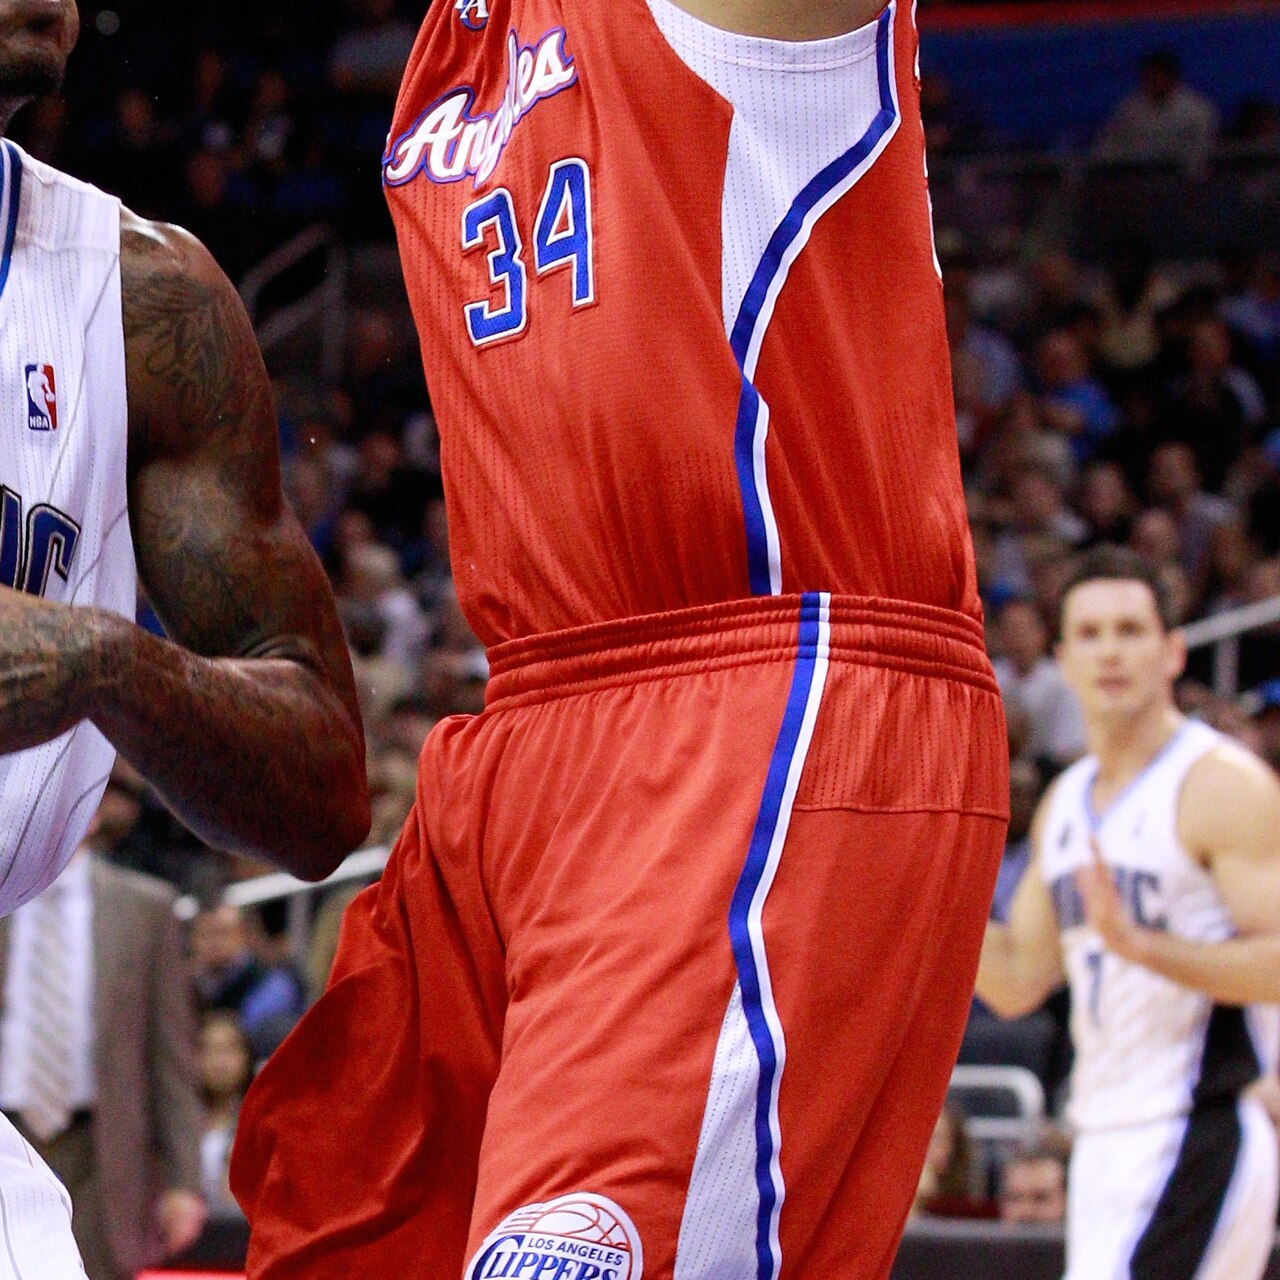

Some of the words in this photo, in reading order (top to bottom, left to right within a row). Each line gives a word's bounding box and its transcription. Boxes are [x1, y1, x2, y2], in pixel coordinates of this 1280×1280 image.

[461, 157, 595, 347] 34
[527, 1237, 555, 1251] LOS
[555, 1240, 625, 1266] ANGELES
